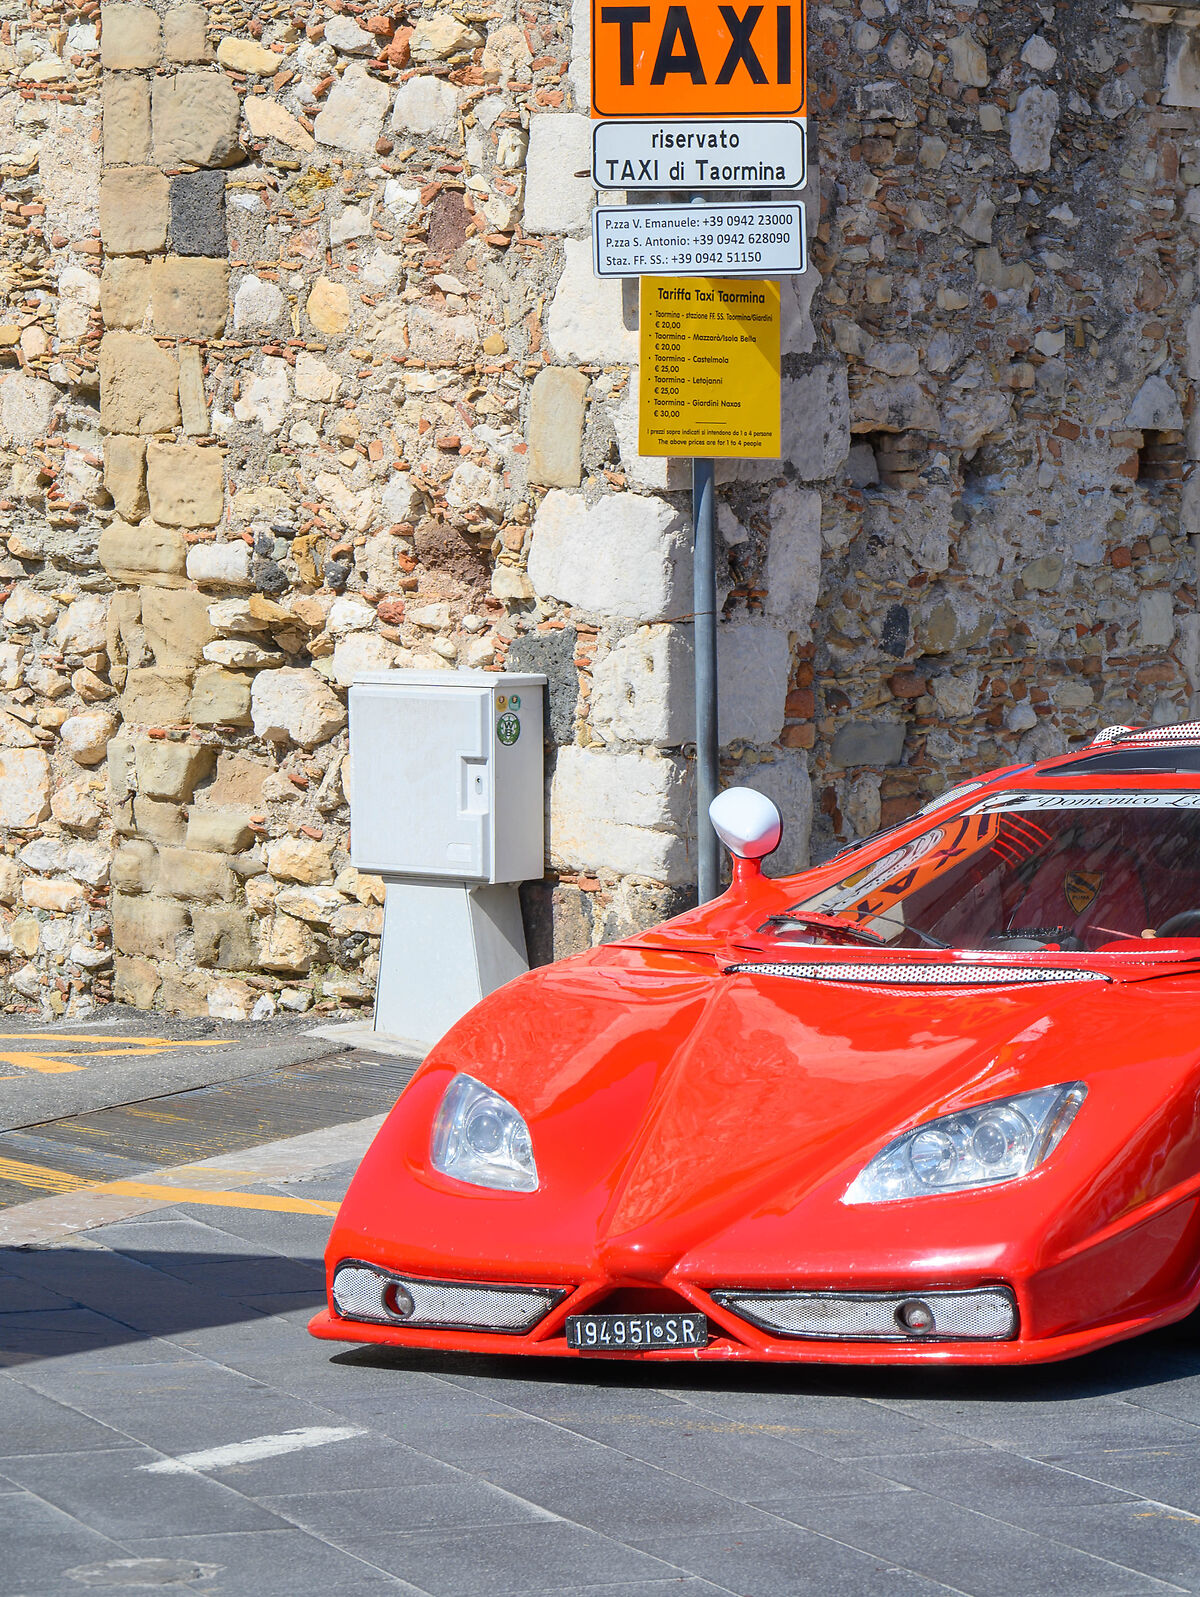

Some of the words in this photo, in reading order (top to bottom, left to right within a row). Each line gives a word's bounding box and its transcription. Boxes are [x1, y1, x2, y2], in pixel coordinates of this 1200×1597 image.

[601, 5, 791, 86] TAXI
[651, 129, 740, 149] riservato
[606, 159, 659, 181] TAXI
[669, 161, 685, 181] di
[695, 159, 786, 181] Taormina
[605, 219, 630, 229] P.zza
[632, 219, 643, 228] V.
[645, 218, 700, 228] Emanuele:
[702, 216, 723, 227] +39
[727, 215, 754, 226] 0942
[758, 214, 793, 225] 23000
[606, 237, 630, 248] P.zza
[633, 237, 643, 247] S.
[645, 236, 690, 247] Antonio:
[693, 234, 714, 245] +39
[717, 234, 745, 245] 0942
[748, 232, 790, 244] 628090
[606, 256, 631, 266] Staz.
[634, 255, 648, 265] FF.
[650, 255, 669, 265] SS.:
[671, 253, 692, 263] +39
[695, 252, 723, 263] 0942
[726, 251, 761, 263] 51150
[658, 288, 691, 300] Tariffa
[695, 289, 715, 301] Taxi
[718, 291, 765, 303] Taormina
[656, 310, 680, 318] Taormina
[686, 312, 707, 320] stazione
[655, 332, 685, 340] Taormina
[693, 356, 729, 364] Castelmola
[693, 377, 722, 385] Letojanni
[660, 410, 680, 418] 30,00
[1035, 793, 1160, 808] Domenico
[575, 1321, 652, 1345] 194951
[665, 1319, 696, 1342] SR
